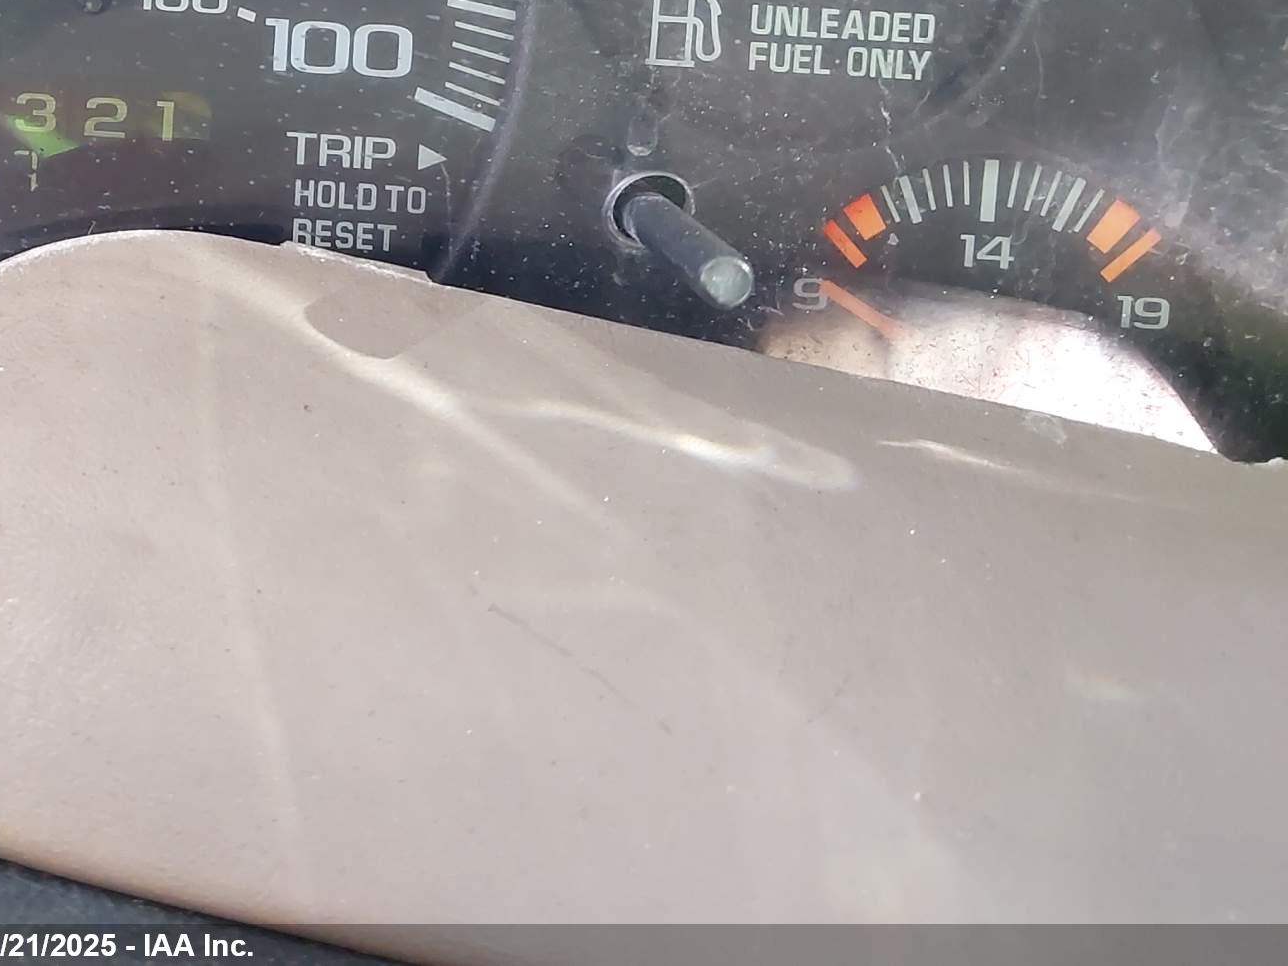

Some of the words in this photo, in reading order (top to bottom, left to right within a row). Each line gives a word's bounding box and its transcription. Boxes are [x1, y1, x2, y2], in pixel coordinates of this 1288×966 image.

[749, 4, 937, 46] UNLEADED
[265, 17, 413, 79] 100
[747, 42, 831, 78] FUEL
[847, 46, 932, 82] ONLY
[286, 131, 397, 170] TRIP
[294, 179, 377, 211] HOLD
[385, 185, 426, 214] TO
[292, 217, 398, 252] RESET
[959, 234, 1015, 270] 14
[792, 278, 827, 311] 9
[1118, 296, 1170, 331] 19
